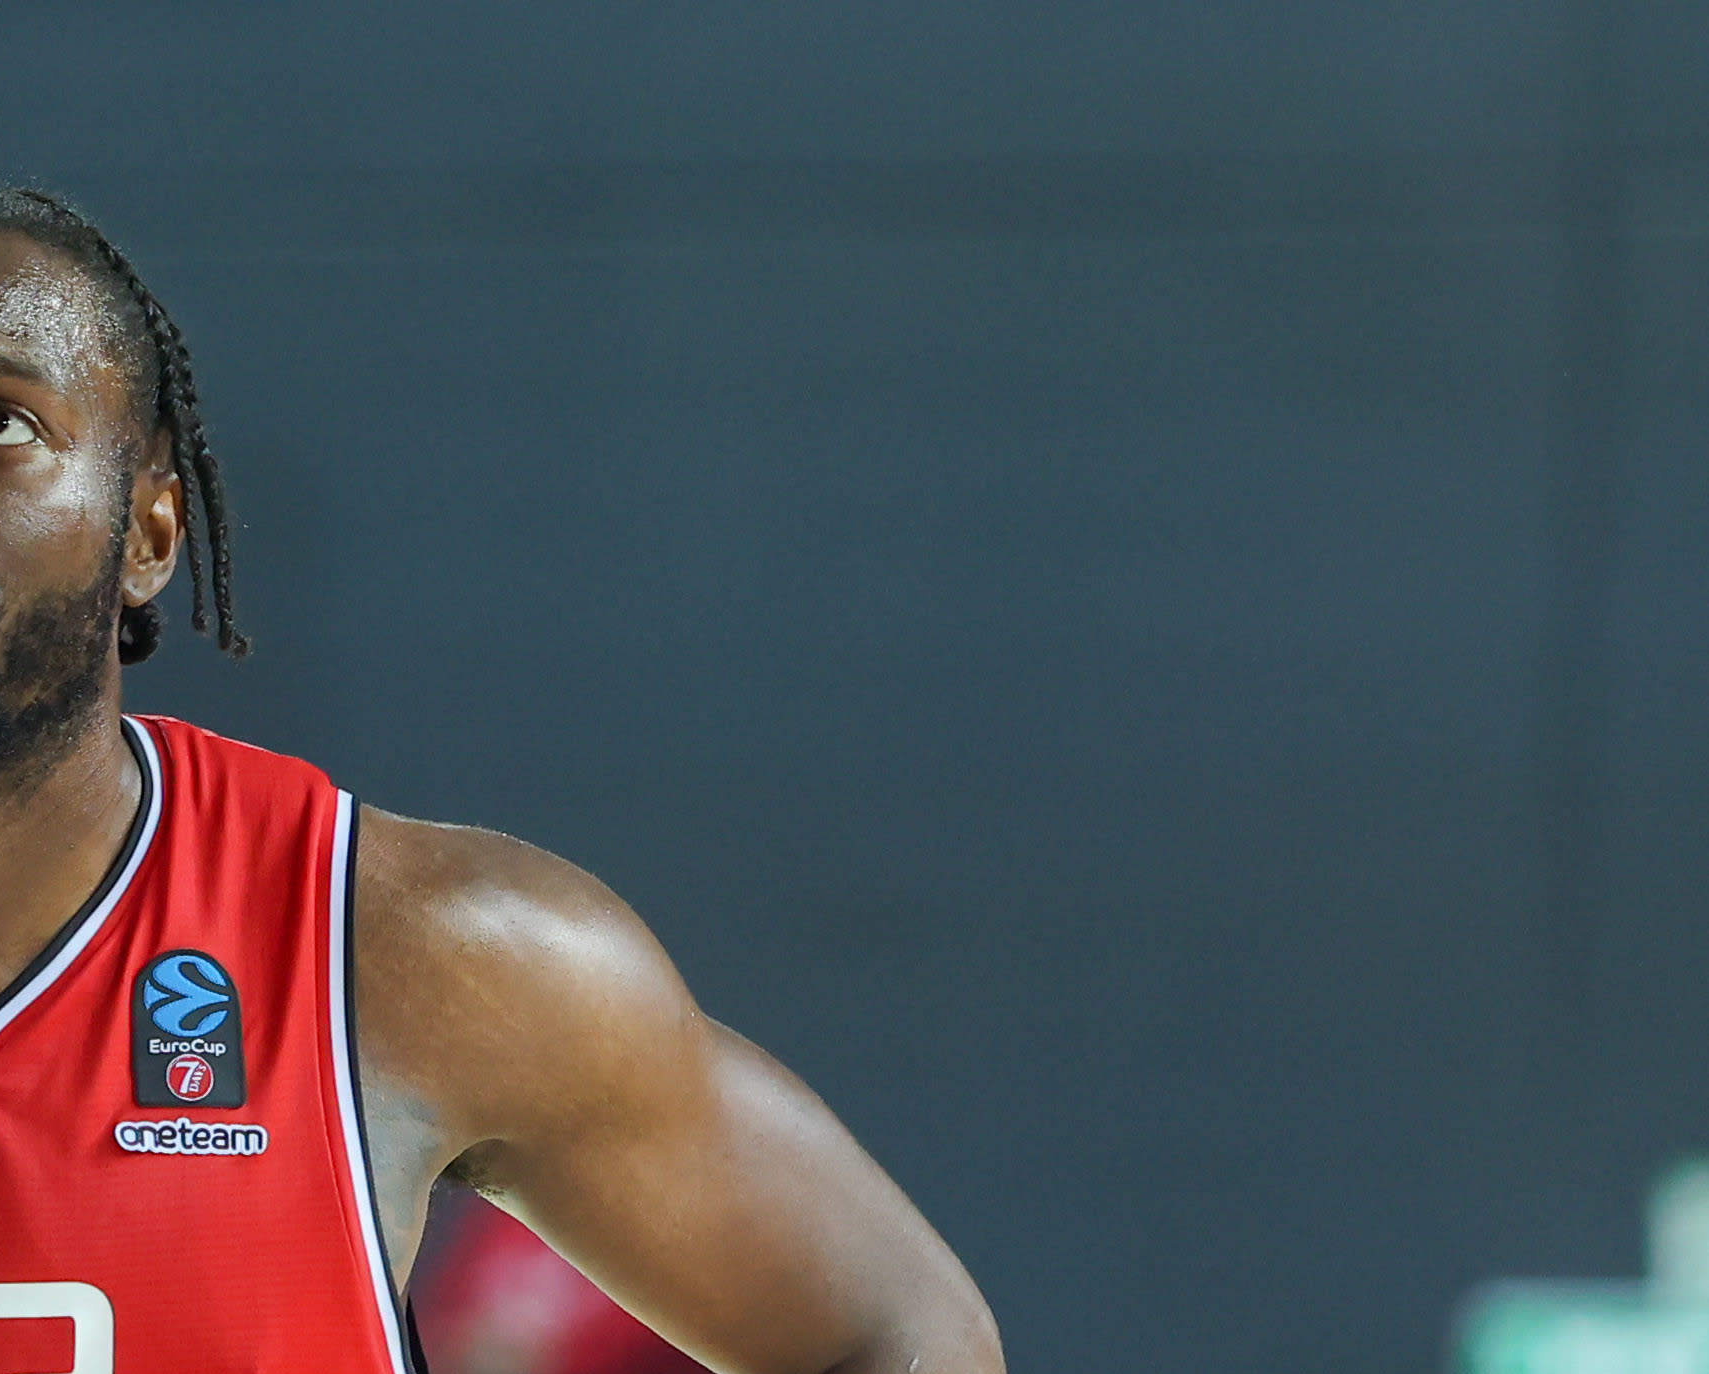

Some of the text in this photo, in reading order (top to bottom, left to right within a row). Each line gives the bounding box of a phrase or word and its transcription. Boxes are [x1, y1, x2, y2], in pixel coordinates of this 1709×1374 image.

[149, 1039, 227, 1056] EuroCup
[175, 1061, 200, 1094] 7
[120, 1121, 263, 1151] oneteam
